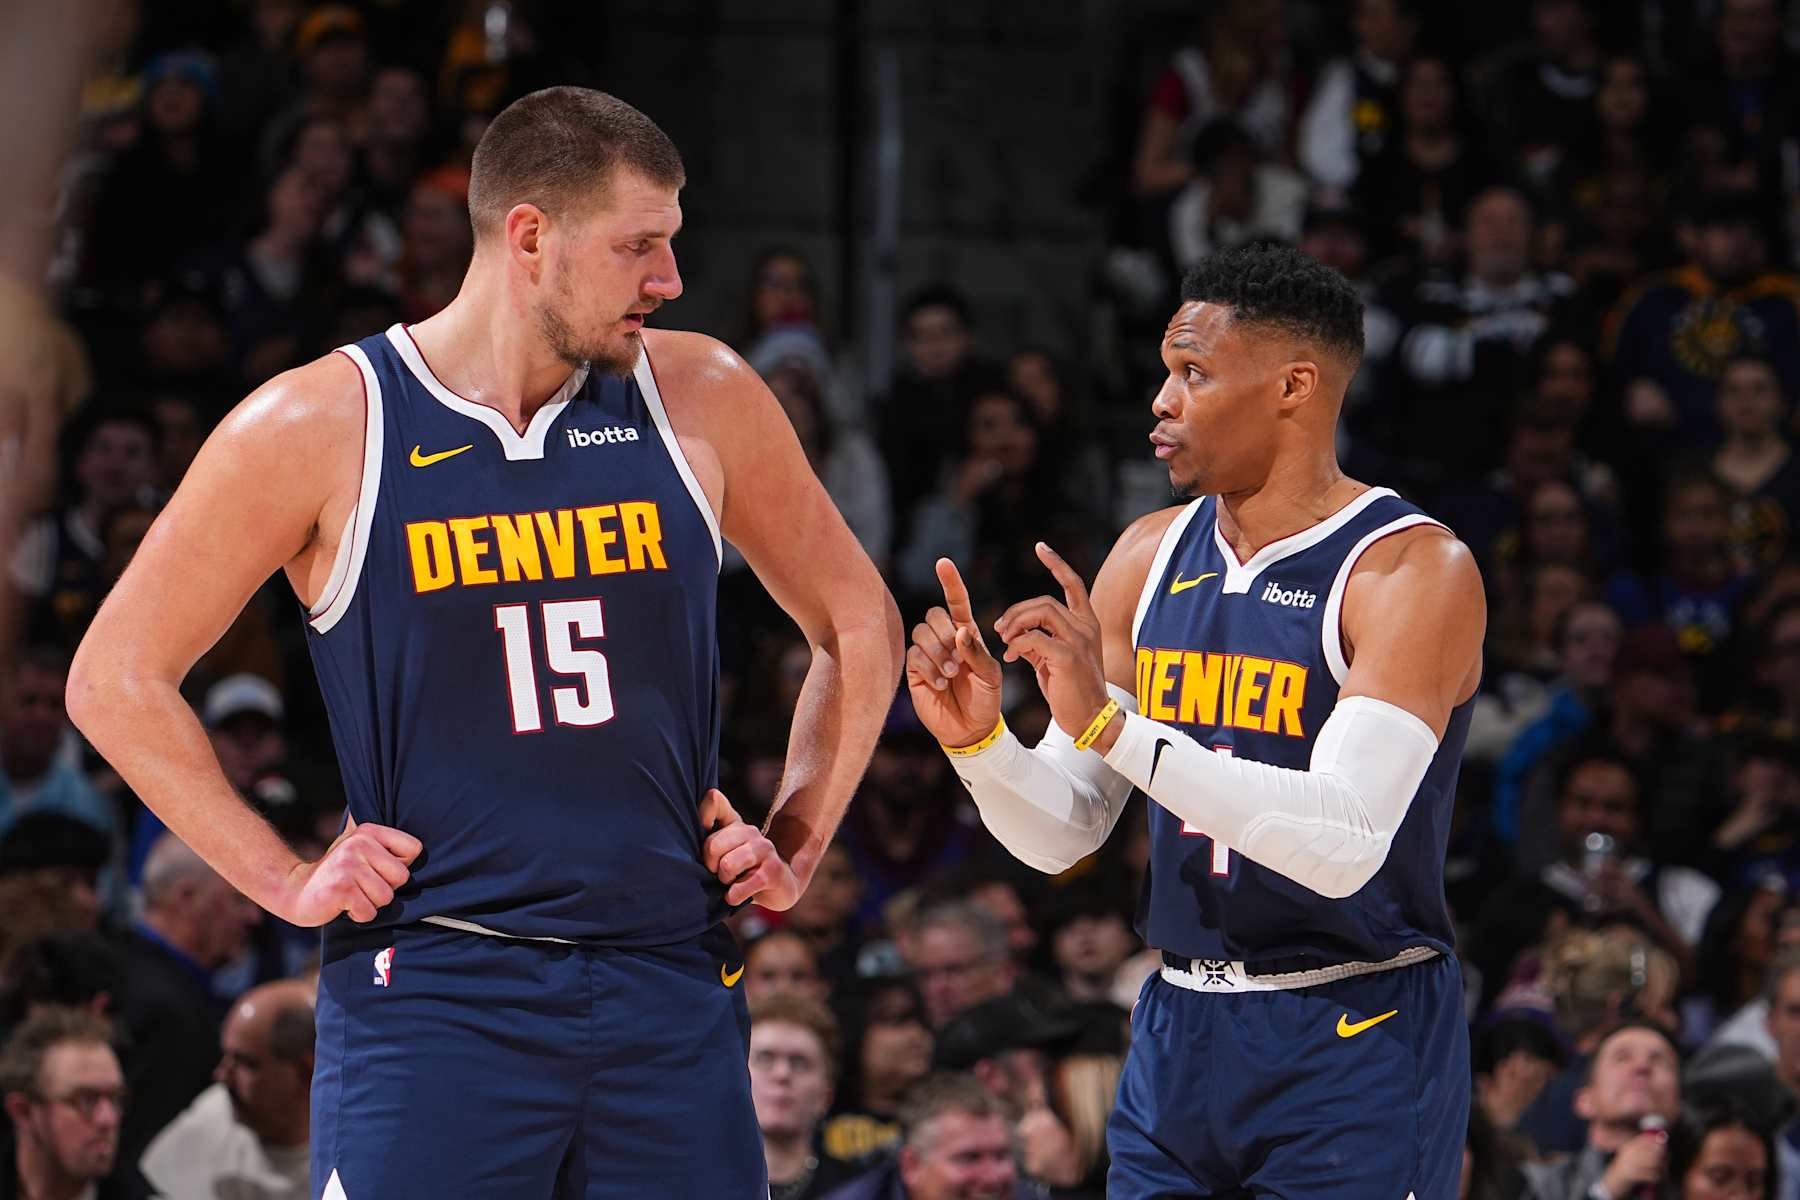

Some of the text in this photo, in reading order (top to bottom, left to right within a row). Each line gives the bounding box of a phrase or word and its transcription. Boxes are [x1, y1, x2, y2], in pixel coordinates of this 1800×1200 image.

[567, 427, 639, 447] ibotta
[404, 501, 669, 594] DENVER
[1261, 581, 1317, 609] ibotta
[493, 597, 616, 735] 15
